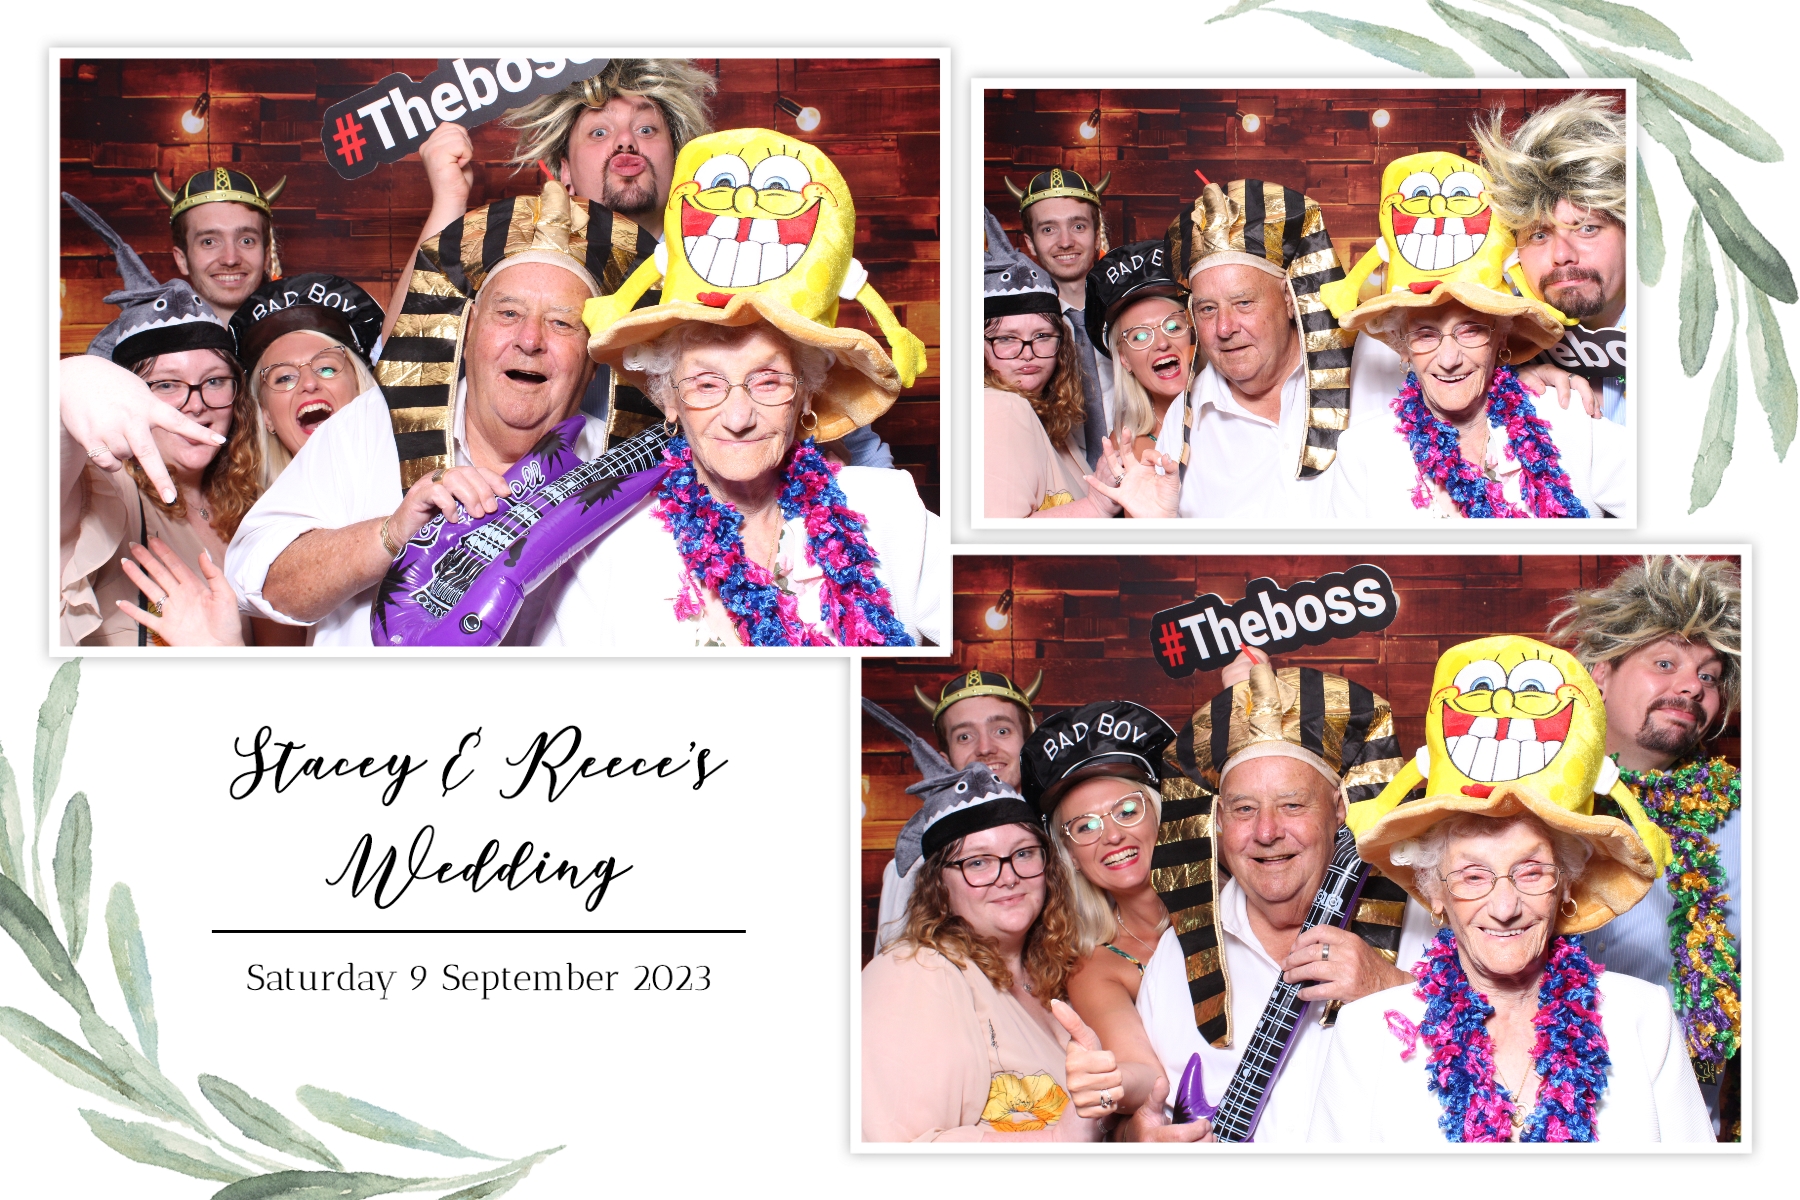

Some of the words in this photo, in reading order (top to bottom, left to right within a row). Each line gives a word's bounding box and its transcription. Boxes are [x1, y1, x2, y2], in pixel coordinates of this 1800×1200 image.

[332, 58, 594, 166] #Thebos
[1106, 255, 1144, 284] BAD
[252, 290, 299, 320] BAD
[307, 282, 357, 313] BOY
[1158, 578, 1386, 667] #Theboss
[1043, 722, 1089, 761] BAD
[1097, 713, 1147, 743] BOY
